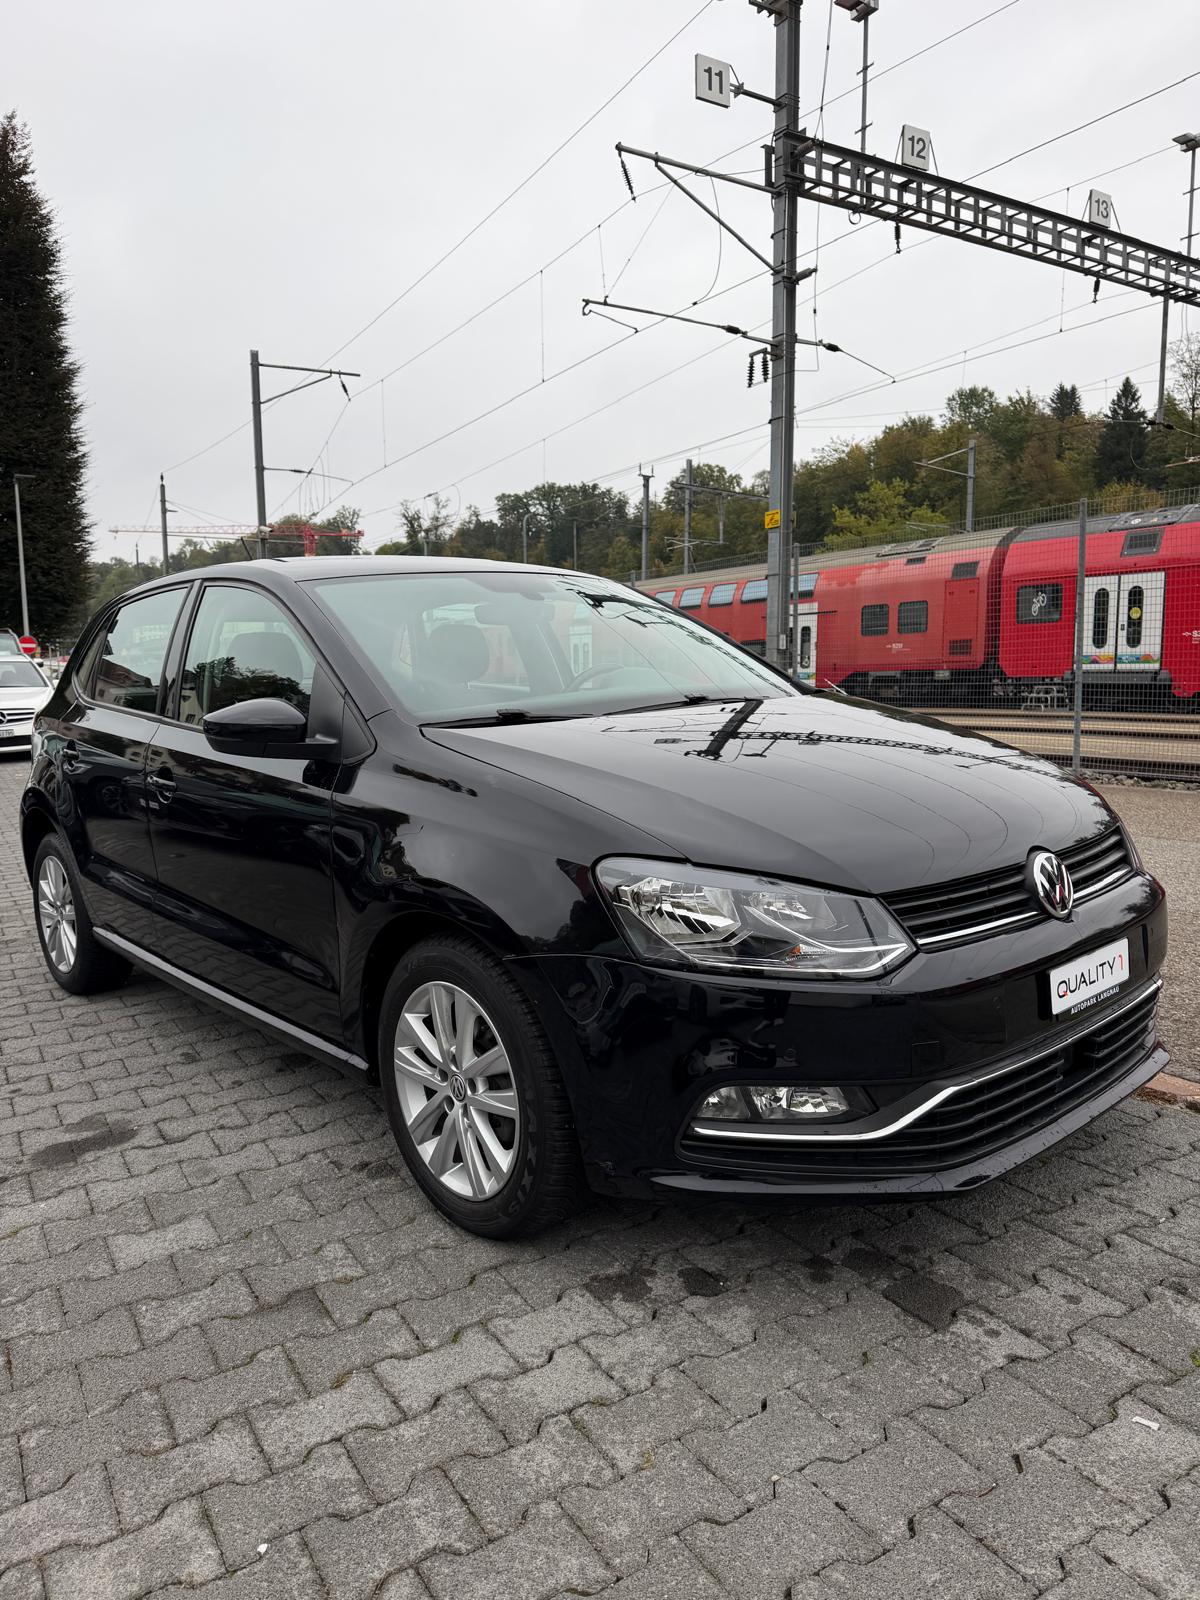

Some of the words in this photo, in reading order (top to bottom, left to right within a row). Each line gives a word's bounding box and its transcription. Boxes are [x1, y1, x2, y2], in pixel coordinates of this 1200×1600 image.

[703, 66, 723, 95] 11
[908, 135, 926, 160] 12
[1094, 198, 1109, 219] 13
[1057, 956, 1116, 999] QUALITY
[1118, 953, 1124, 971] 1
[1070, 997, 1098, 1015] AUTOPARK
[1097, 985, 1120, 1002] LANGNAU
